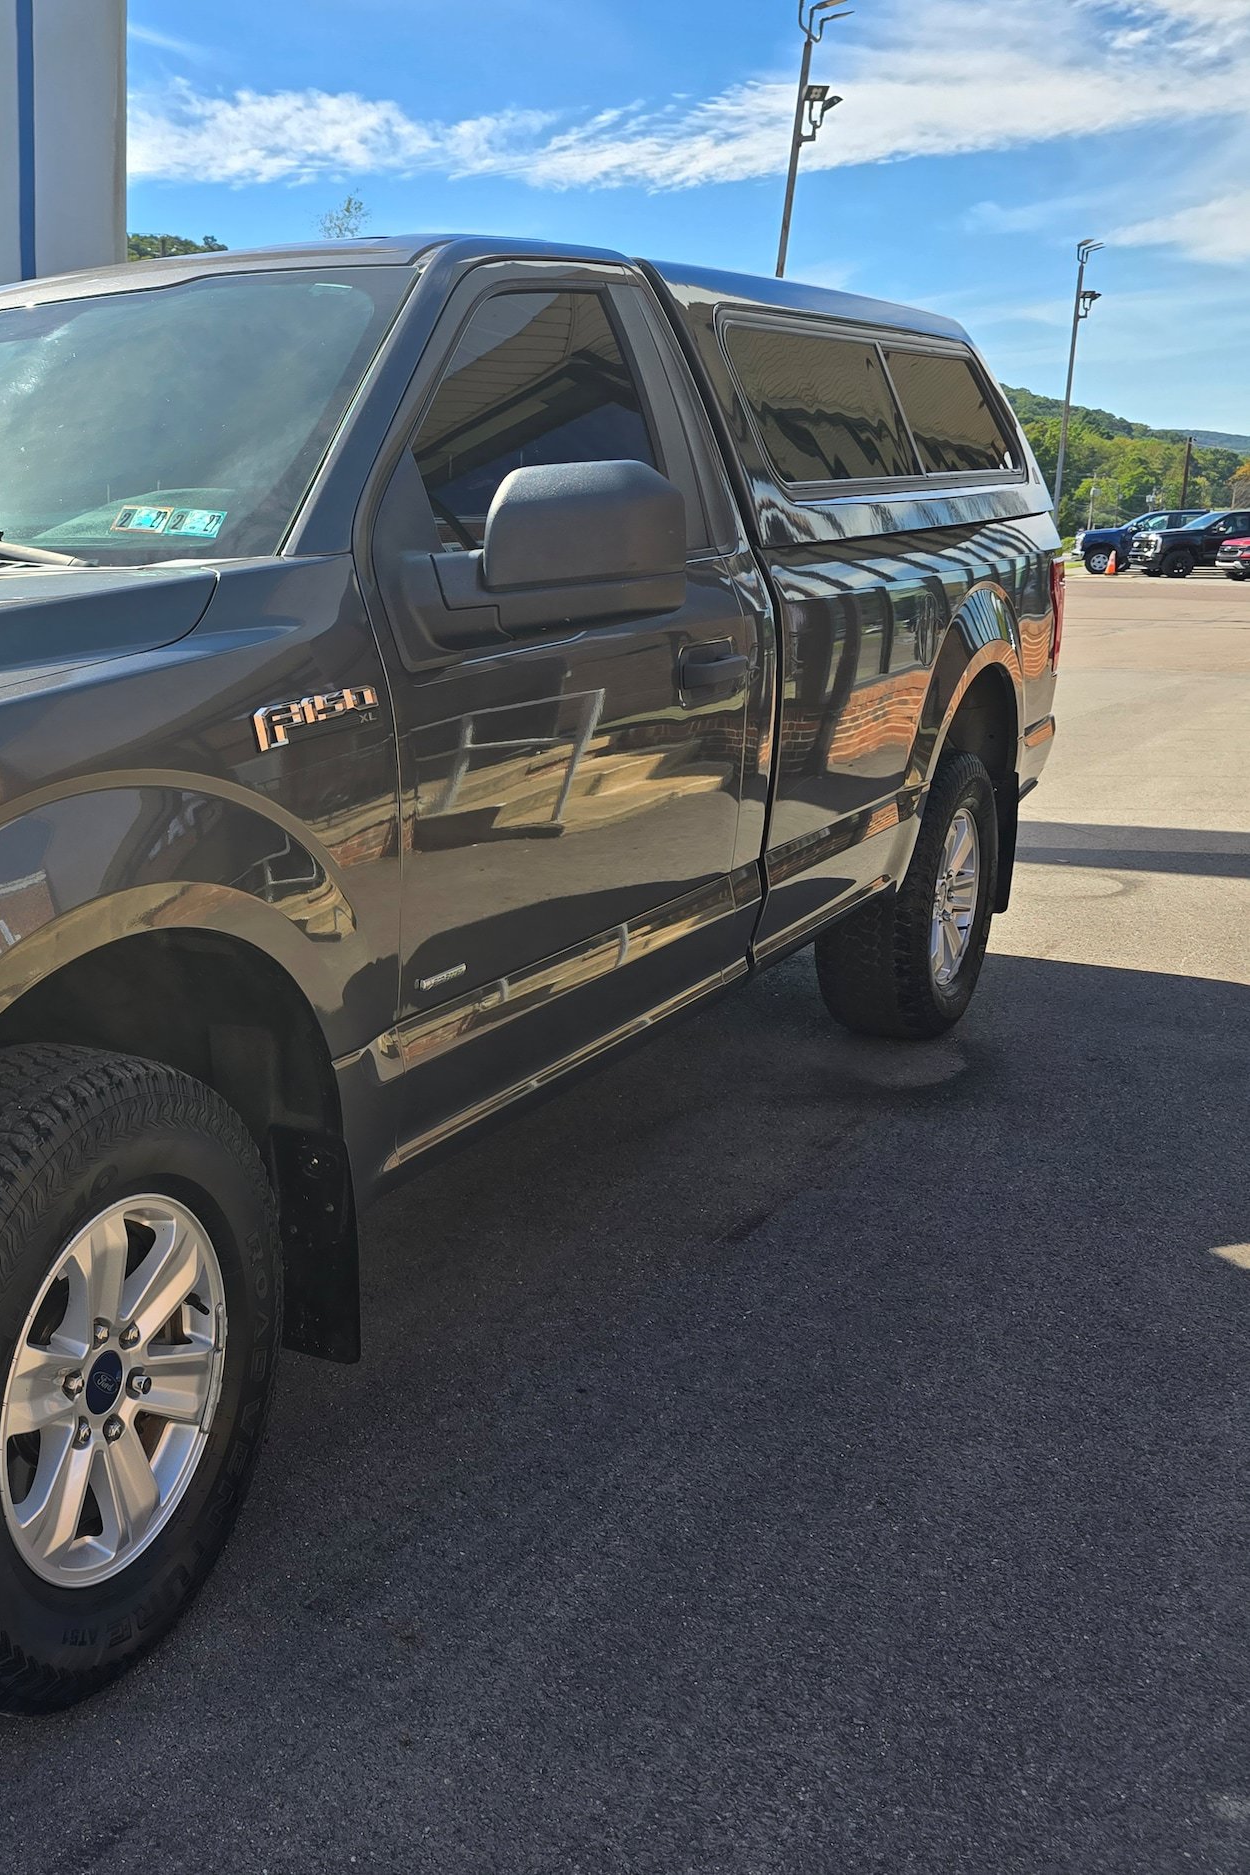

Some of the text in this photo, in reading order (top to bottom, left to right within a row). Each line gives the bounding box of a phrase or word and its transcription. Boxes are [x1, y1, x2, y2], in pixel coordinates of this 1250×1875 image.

[119, 511, 167, 528] 2 27
[170, 514, 221, 532] 2 27
[358, 712, 378, 724] XL
[96, 1374, 115, 1392] Ford
